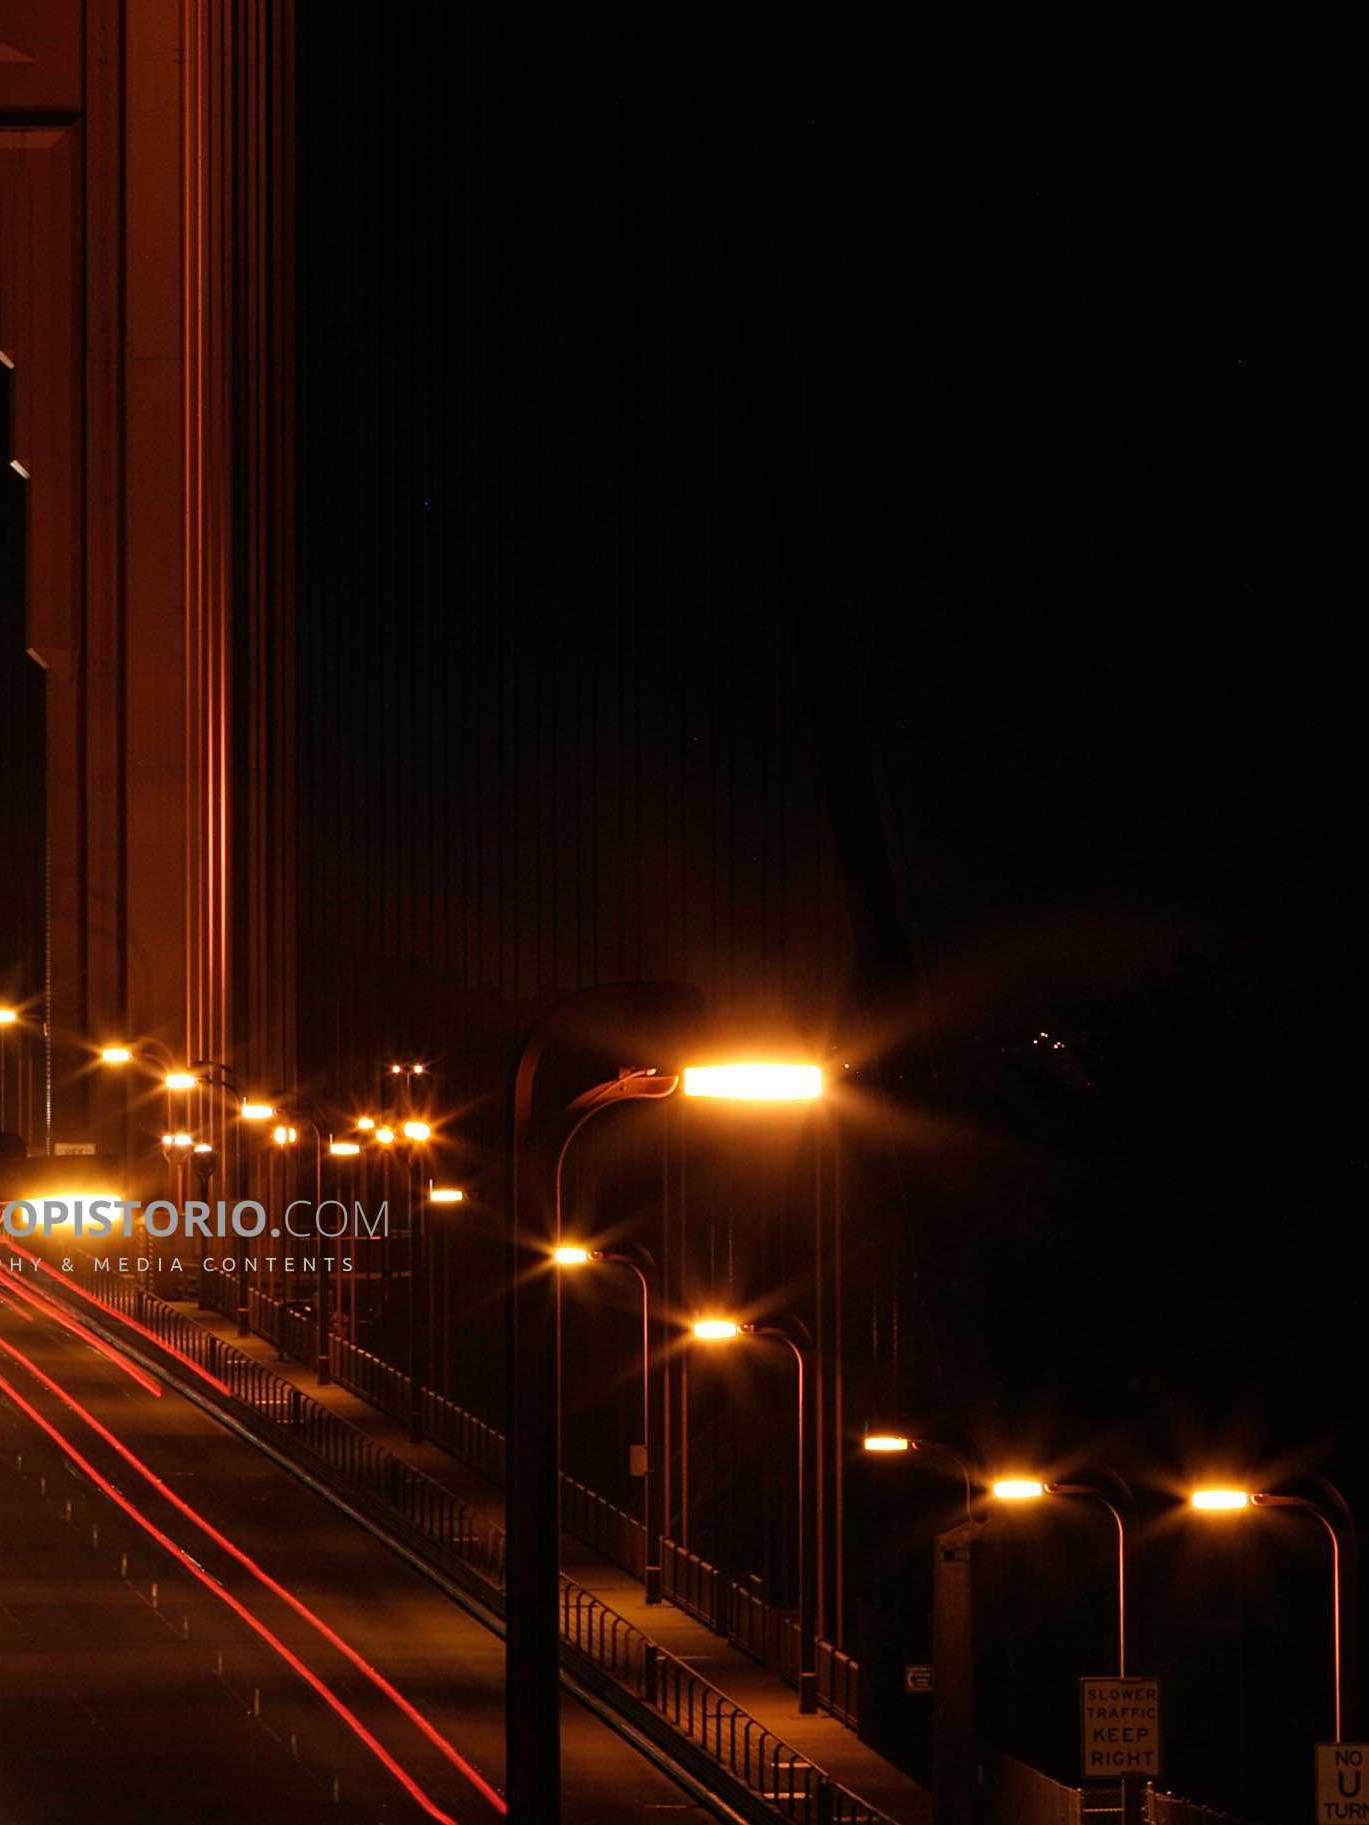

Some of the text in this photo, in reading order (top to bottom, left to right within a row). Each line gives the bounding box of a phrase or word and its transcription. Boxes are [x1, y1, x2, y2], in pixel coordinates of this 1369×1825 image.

[1088, 1688, 1157, 1701] SLOWER
[1087, 1707, 1157, 1720] TRAFFIC
[1093, 1727, 1149, 1743] KEEP
[1091, 1751, 1153, 1767] RIGHT
[1335, 1750, 1363, 1768] NO
[1338, 1771, 1361, 1798] U
